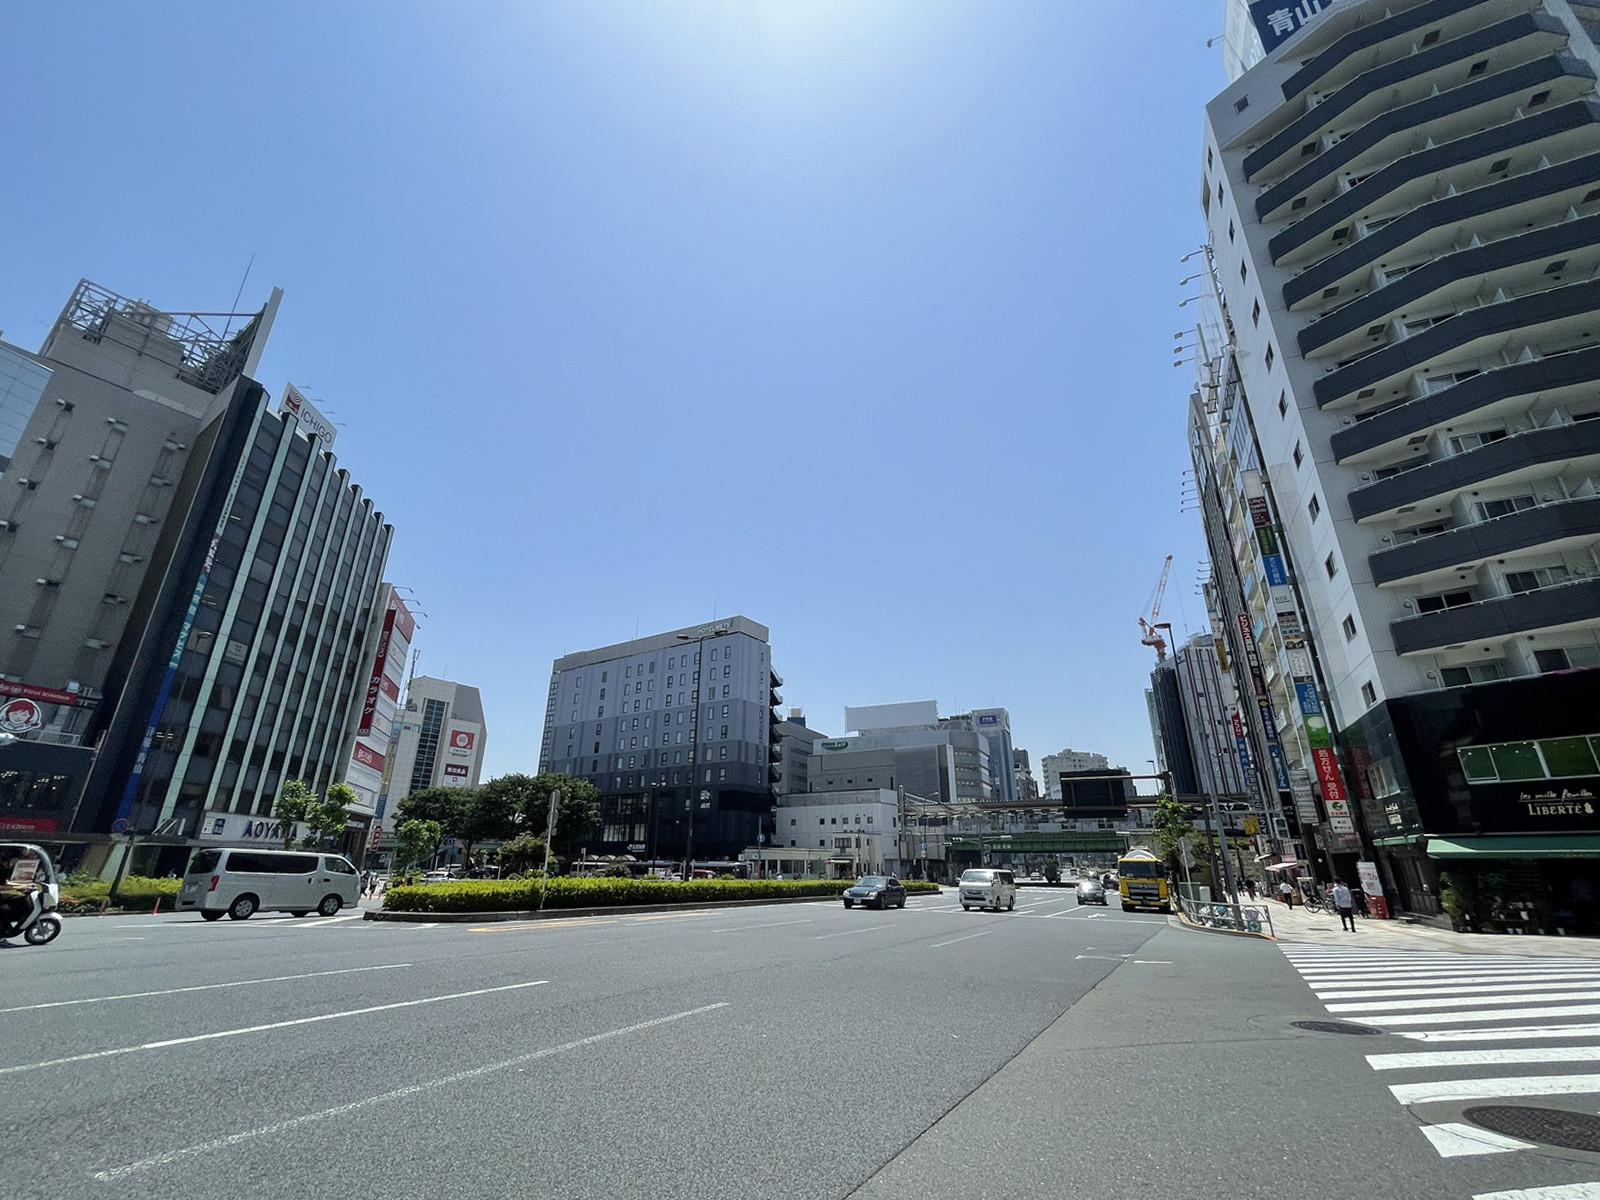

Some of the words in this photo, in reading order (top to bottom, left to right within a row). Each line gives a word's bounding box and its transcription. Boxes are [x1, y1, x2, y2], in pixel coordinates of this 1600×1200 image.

[1267, 0, 1322, 36] 青山
[300, 408, 333, 444] ICHIGO
[364, 676, 380, 714] カラオケ
[242, 821, 298, 840] AOYAA
